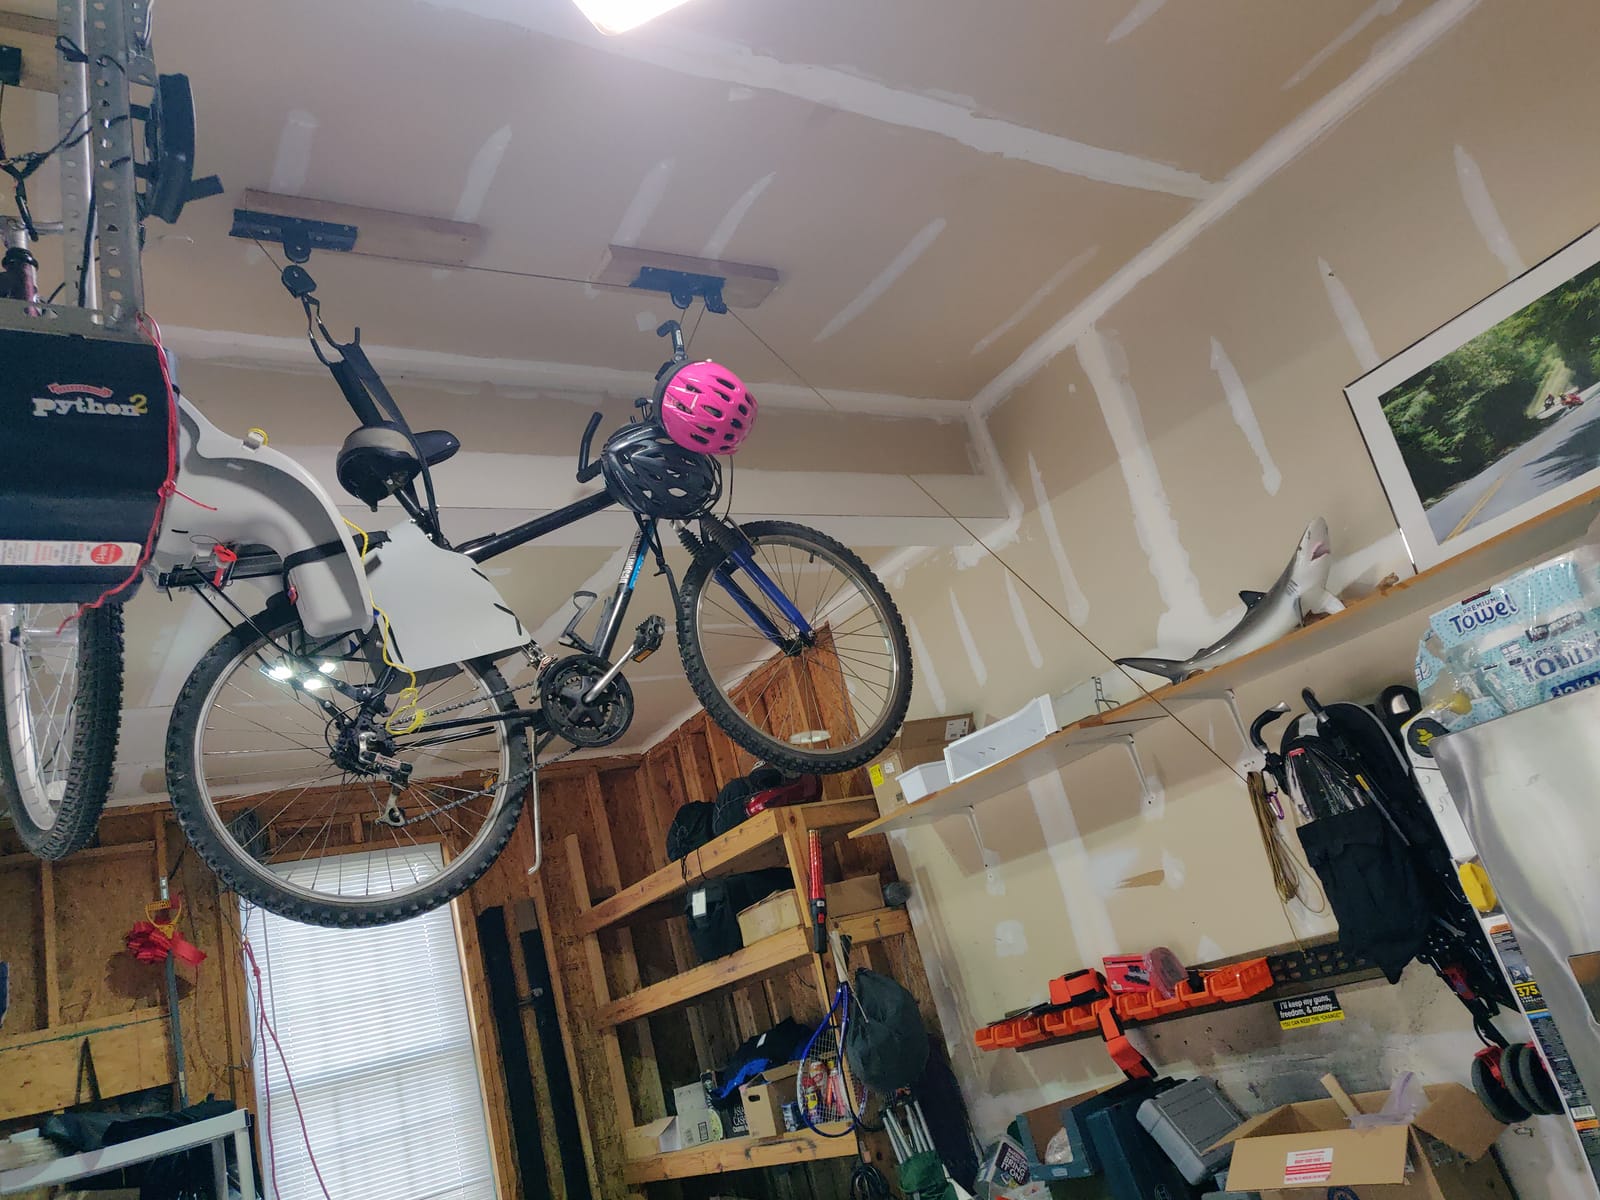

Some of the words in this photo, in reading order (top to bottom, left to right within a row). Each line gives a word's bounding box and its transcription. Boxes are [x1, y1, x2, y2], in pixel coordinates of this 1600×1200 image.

[1449, 594, 1517, 633] Towel
[1463, 596, 1496, 614] PREMIUM
[1517, 985, 1538, 997] 375
[1280, 1008, 1306, 1019] freedom,
[1306, 1005, 1312, 1014] &
[1288, 1000, 1303, 1009] keep
[1303, 998, 1313, 1006] my
[1000, 1162, 1009, 1171] IT
[1009, 1168, 1024, 1184] ON!
[1003, 1156, 1026, 1176] BRING
